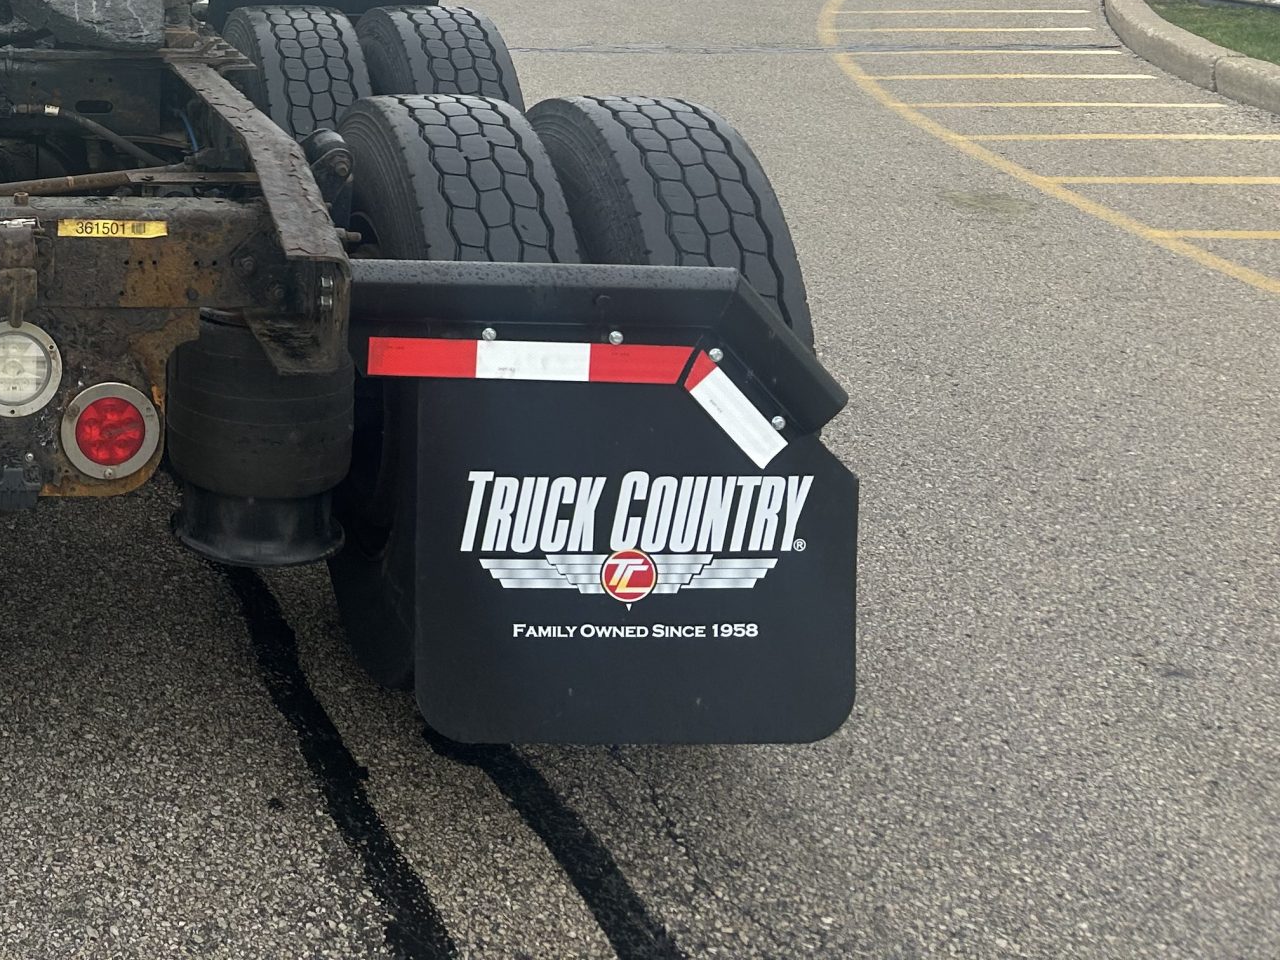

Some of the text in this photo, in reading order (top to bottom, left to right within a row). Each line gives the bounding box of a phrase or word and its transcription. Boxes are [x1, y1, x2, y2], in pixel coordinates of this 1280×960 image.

[75, 222, 126, 235] 361501
[460, 471, 607, 552] TRUCK
[512, 623, 759, 638] FAMILY OWNED SINCE 1958
